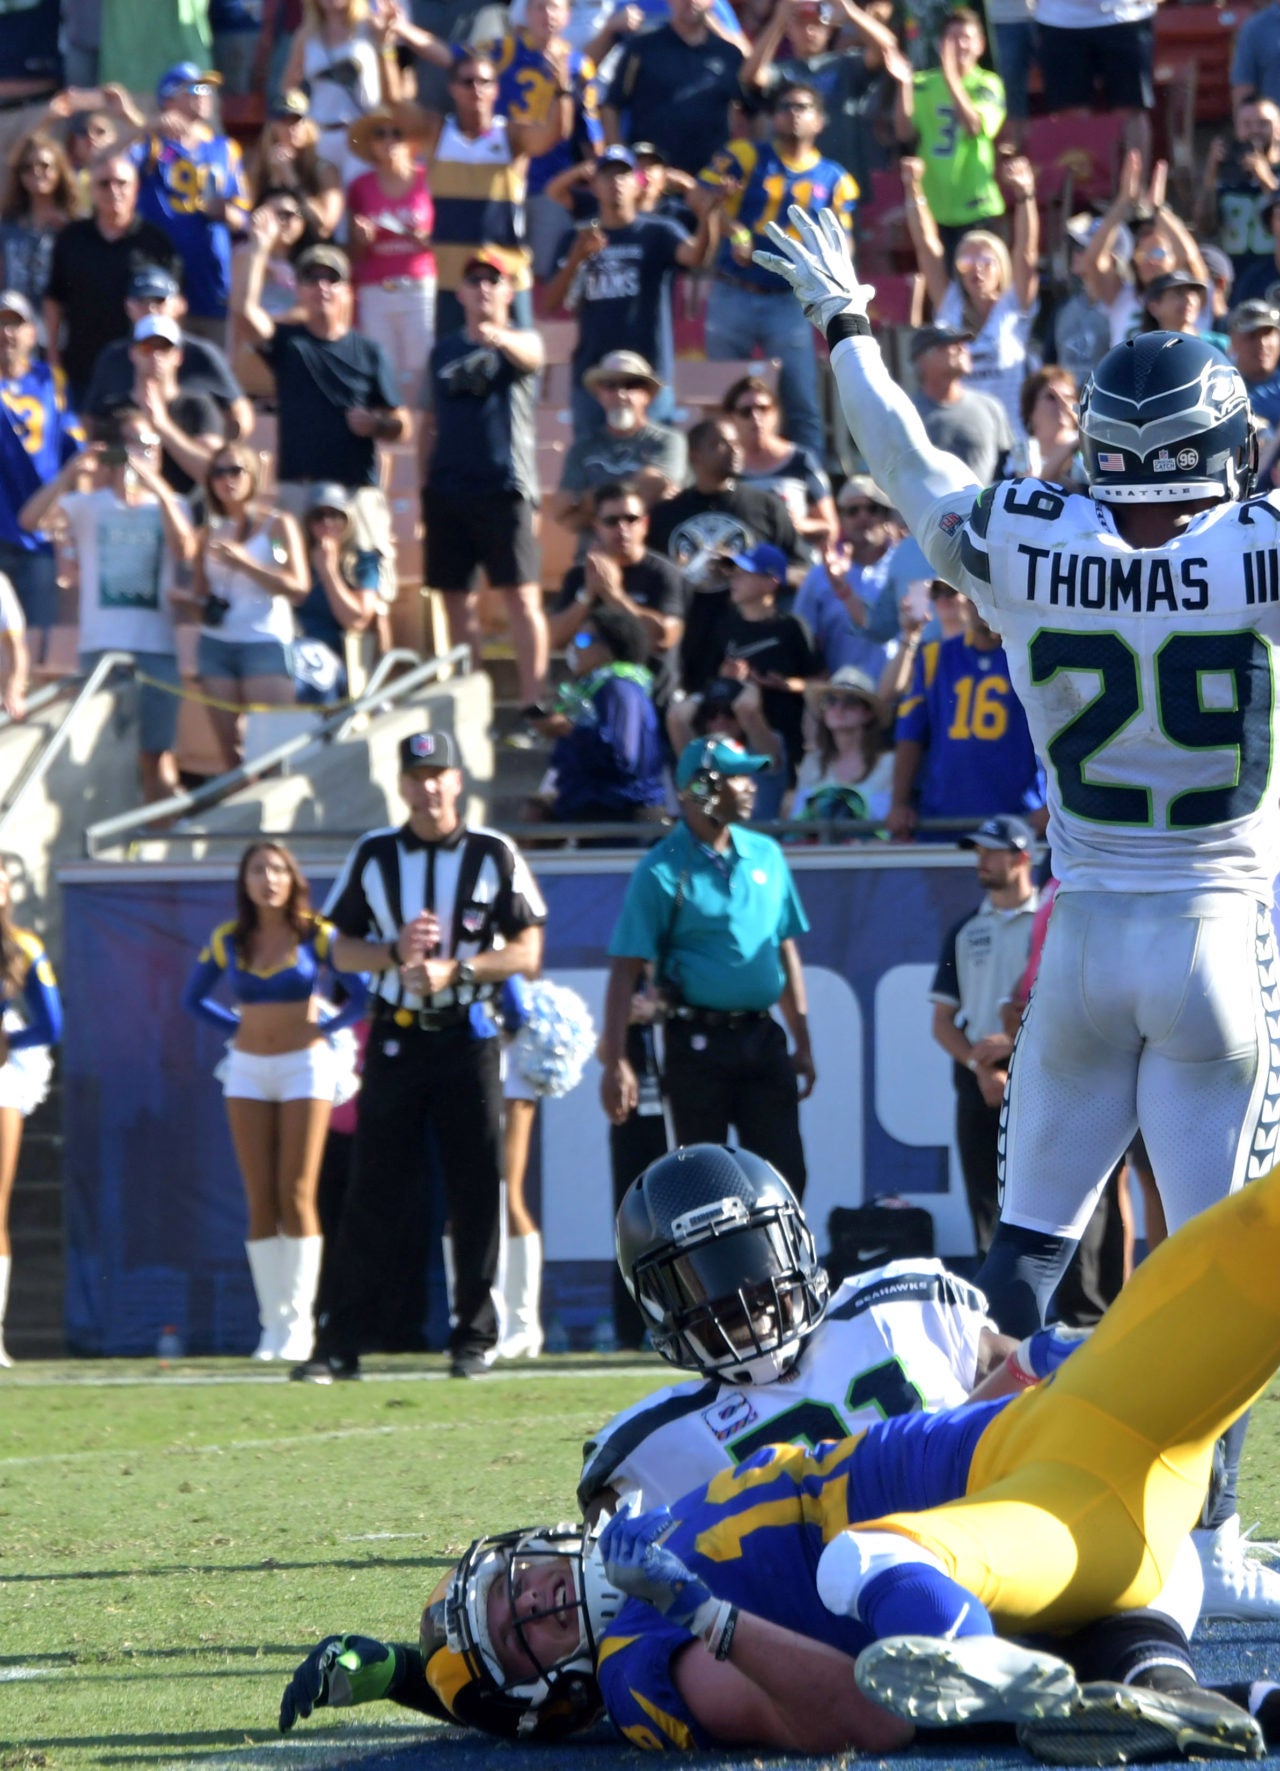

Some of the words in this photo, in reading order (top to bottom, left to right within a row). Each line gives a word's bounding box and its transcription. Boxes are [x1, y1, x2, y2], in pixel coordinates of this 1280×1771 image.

[1104, 487, 1191, 497] SEATTLE
[1180, 452, 1196, 467] 96
[1018, 544, 1209, 612] THOMAS
[1243, 548, 1280, 604] III
[948, 675, 1008, 740] 16
[1028, 627, 1275, 829] 29
